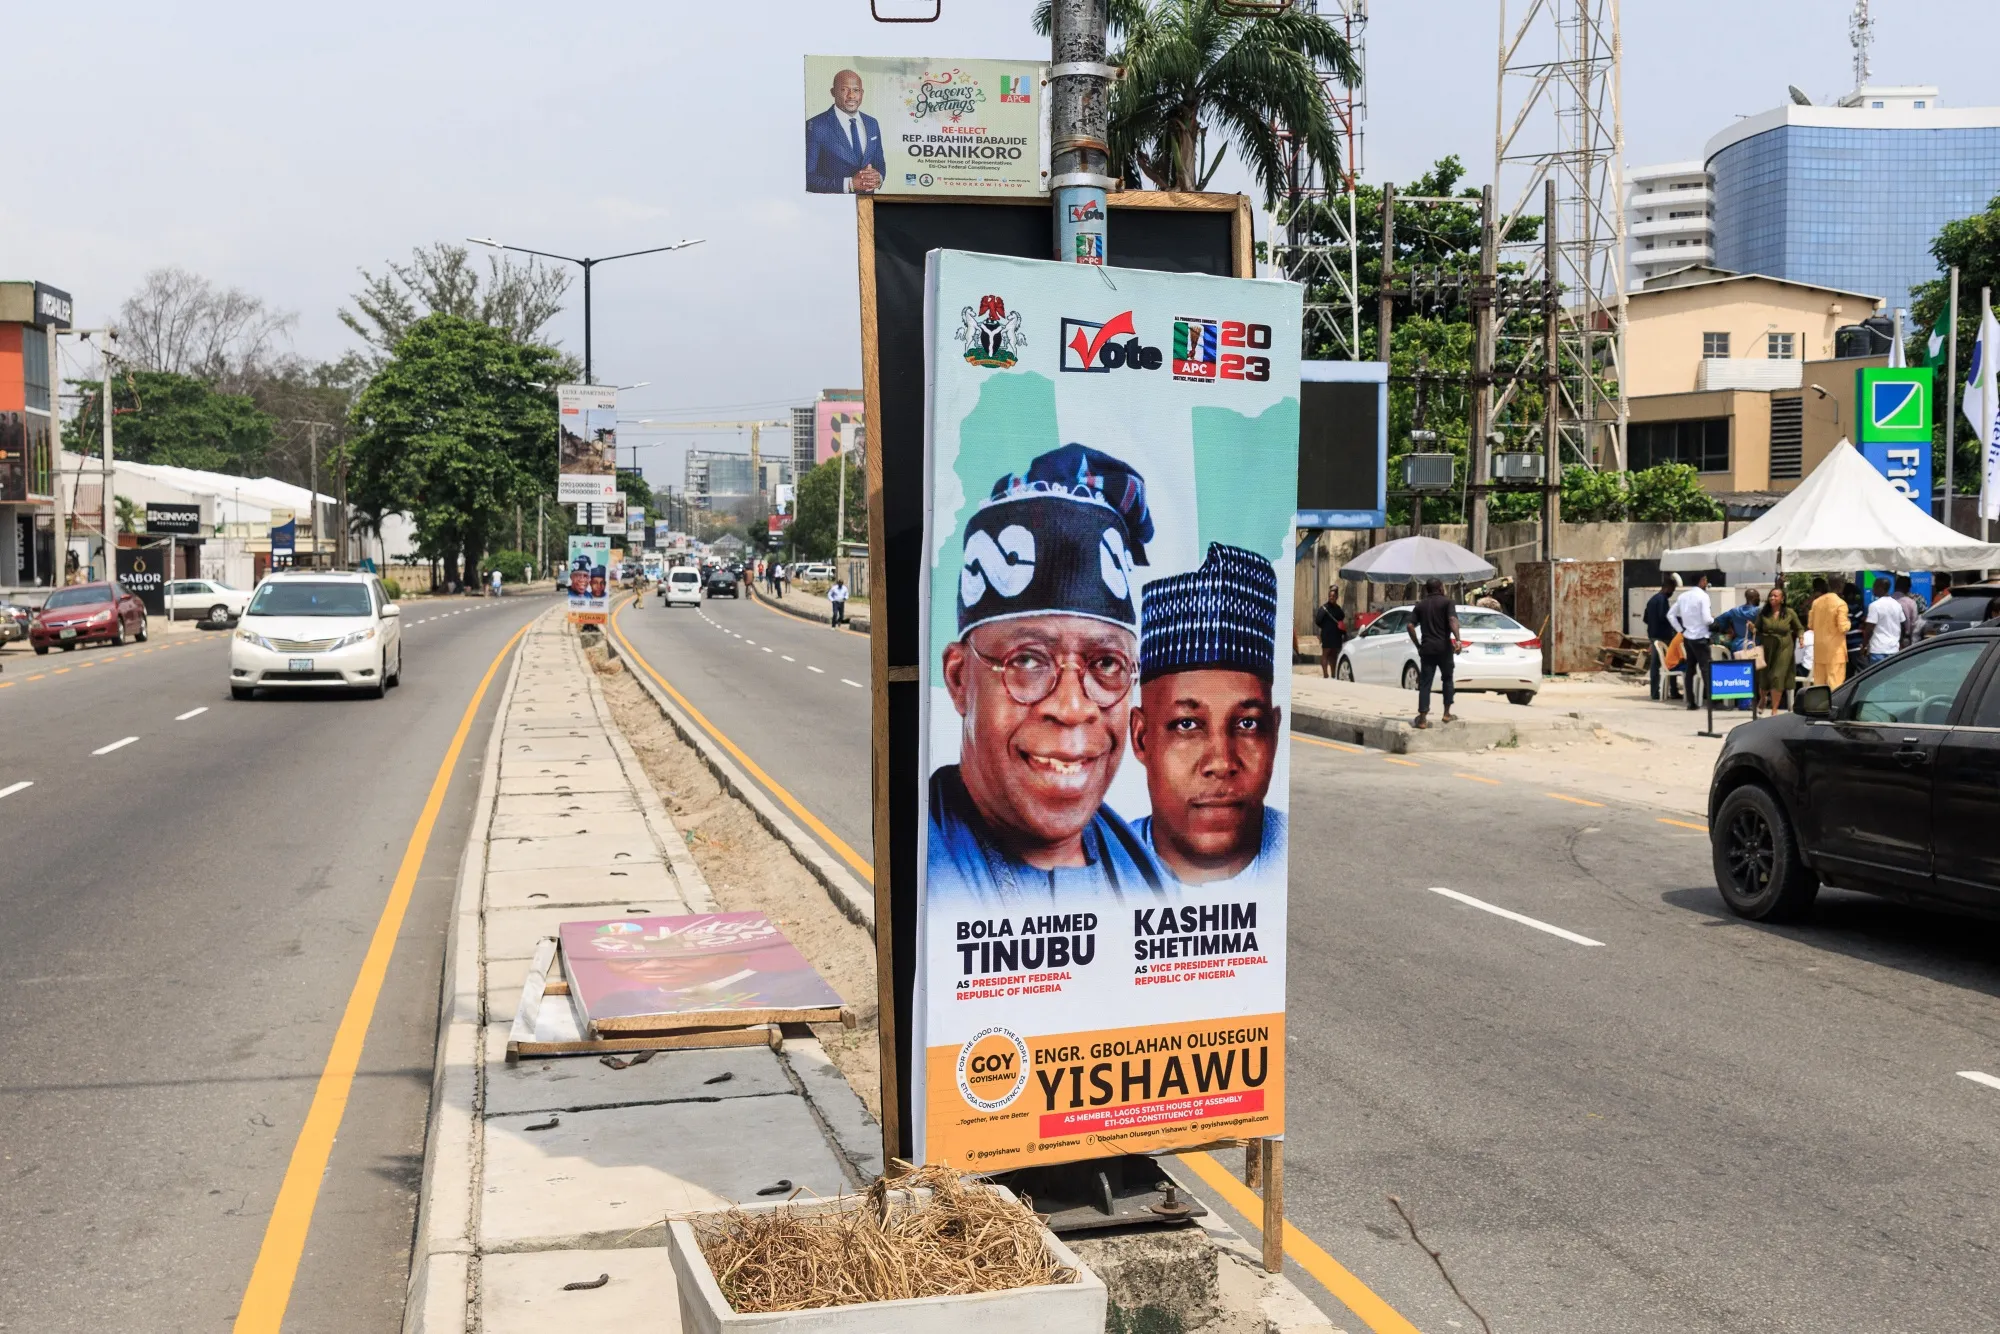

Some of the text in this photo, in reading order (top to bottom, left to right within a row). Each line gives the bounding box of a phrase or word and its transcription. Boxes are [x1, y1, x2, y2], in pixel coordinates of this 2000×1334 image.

[917, 82, 973, 100] Season's
[1006, 95, 1025, 103] APC
[915, 99, 975, 118] Greetings
[902, 134, 1027, 145] REP. IBRAHIM BABAJIDE
[942, 126, 987, 135] RE-ELECT
[908, 144, 1022, 160] OBANIKORO
[1068, 310, 1163, 371] Vote
[1221, 320, 1272, 350] 20
[1182, 362, 1208, 375] APC
[1220, 353, 1271, 382] 23
[120, 573, 162, 584] SABOR
[1724, 679, 1750, 688] Parking
[957, 913, 1098, 941] BOLA AHMED
[1134, 902, 1258, 937] KASHIM
[957, 934, 1096, 975] TINUBU
[1134, 931, 1259, 961] SHETIMMA
[1134, 955, 1268, 975] AS VICE PRESIDENT FEDERAL
[957, 972, 1072, 990] AS PRESIDENT FEDERAL
[1135, 969, 1236, 986] REPUBLIC OF NIGERIA
[957, 984, 1062, 1001] REPUBLIC OF NIGERIA
[964, 1041, 974, 1055] THE
[973, 1028, 992, 1042] GOOD
[1004, 1028, 1016, 1040] THE
[1015, 1037, 1028, 1064] PEOPLE
[1035, 1027, 1269, 1065] ENGR. GBOLAHAN OLUSEGUN
[972, 1053, 1015, 1074] GOY
[970, 1073, 1017, 1084] GOYISHAWU
[1036, 1046, 1269, 1111] YISHAWU
[960, 1082, 979, 1106] ETI-OSA
[978, 1086, 1021, 1109] CONSTITUENCY
[1064, 1095, 1243, 1124] AS MEMBER, LAGOS STATE HOUSE OF ASSEMBLY
[1105, 1109, 1204, 1128] ETI-OSA CONSTITUENCY 02
[1201, 1116, 1270, 1130] goyishawu@gmail.com
[1098, 1125, 1188, 1143] Gbolahan Olusegun Yishawu
[978, 1146, 1021, 1159] @goyishawu
[1038, 1139, 1081, 1151] @goyishawu
